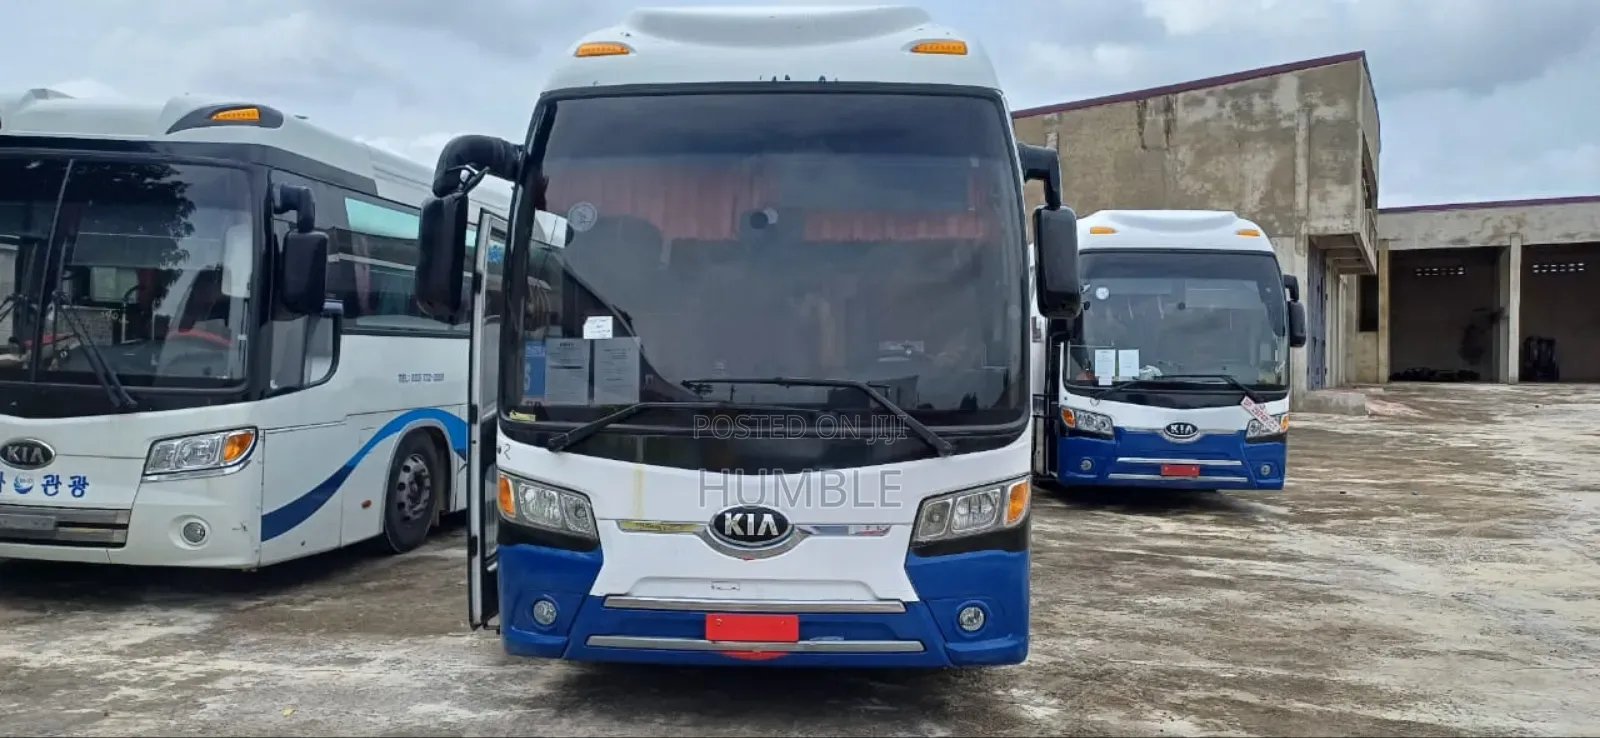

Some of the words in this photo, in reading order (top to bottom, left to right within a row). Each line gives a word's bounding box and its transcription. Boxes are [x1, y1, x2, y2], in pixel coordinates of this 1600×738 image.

[1170, 424, 1194, 434] KIA
[7, 446, 45, 463] KIA
[725, 513, 779, 536] KIA
